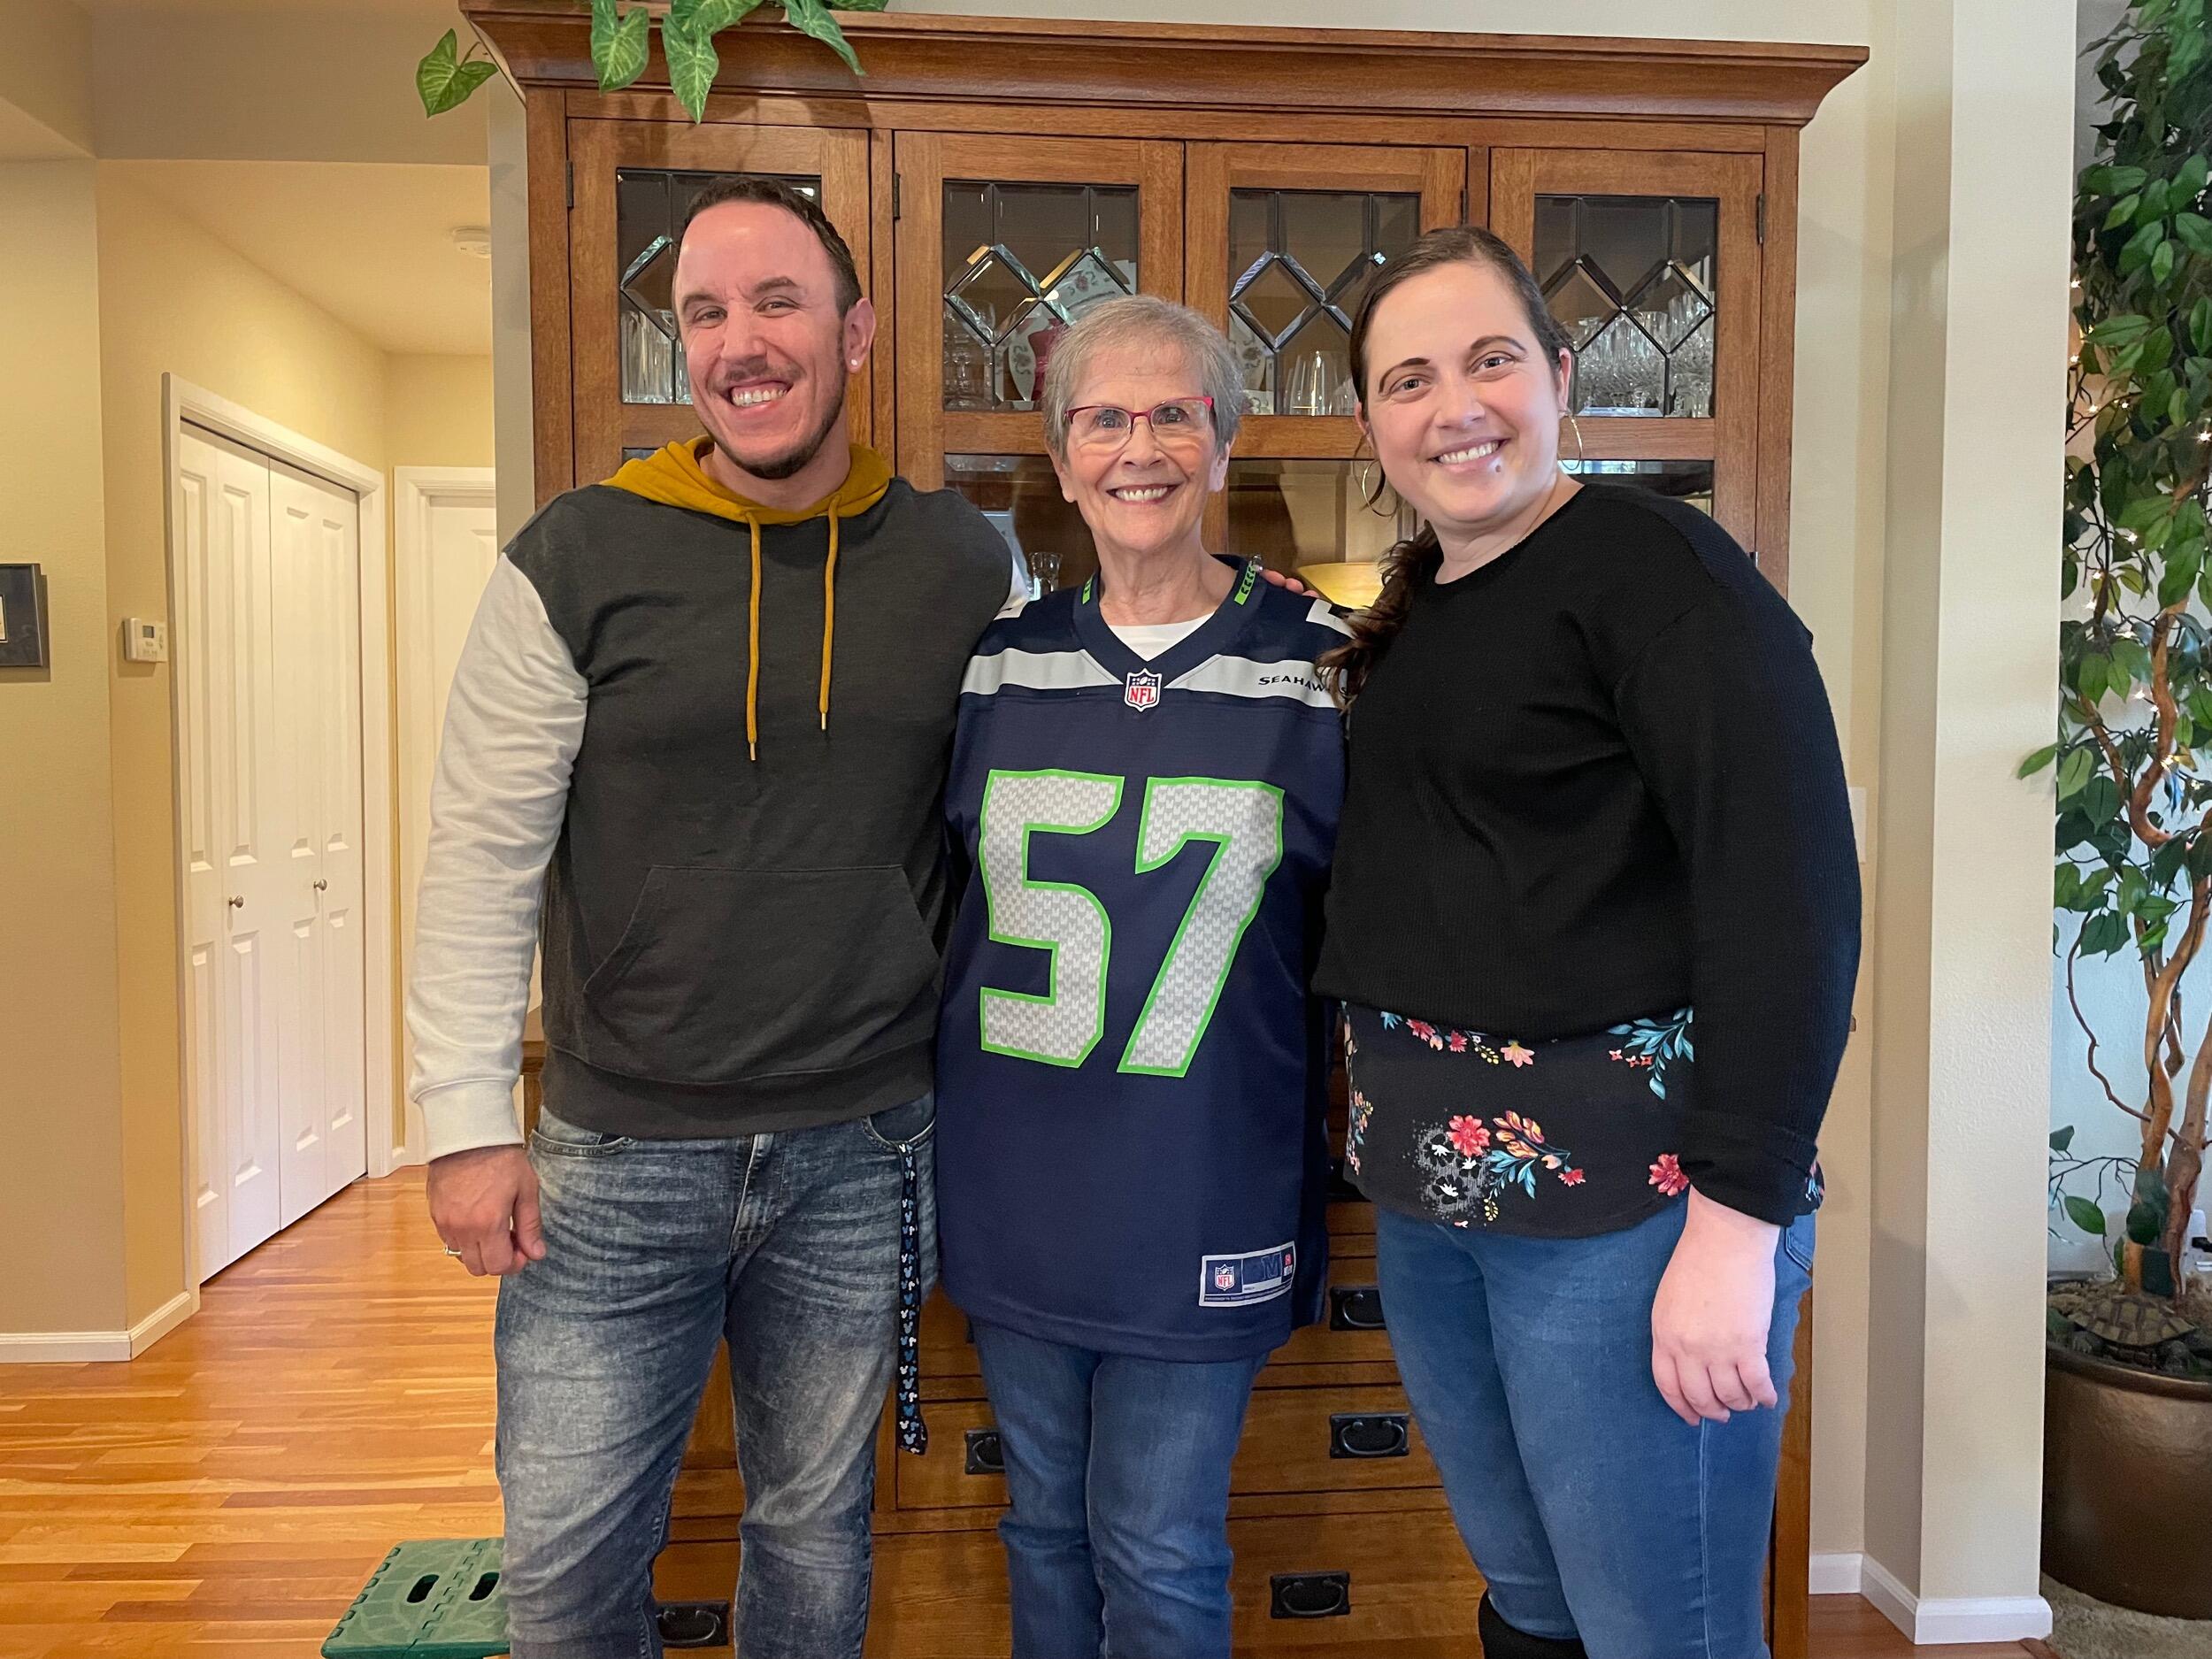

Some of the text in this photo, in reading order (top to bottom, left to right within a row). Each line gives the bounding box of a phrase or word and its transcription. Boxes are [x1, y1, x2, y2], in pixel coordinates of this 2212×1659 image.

[1129, 687, 1155, 704] NFL
[979, 769, 1286, 1078] 57
[1217, 1275, 1233, 1286] NFL
